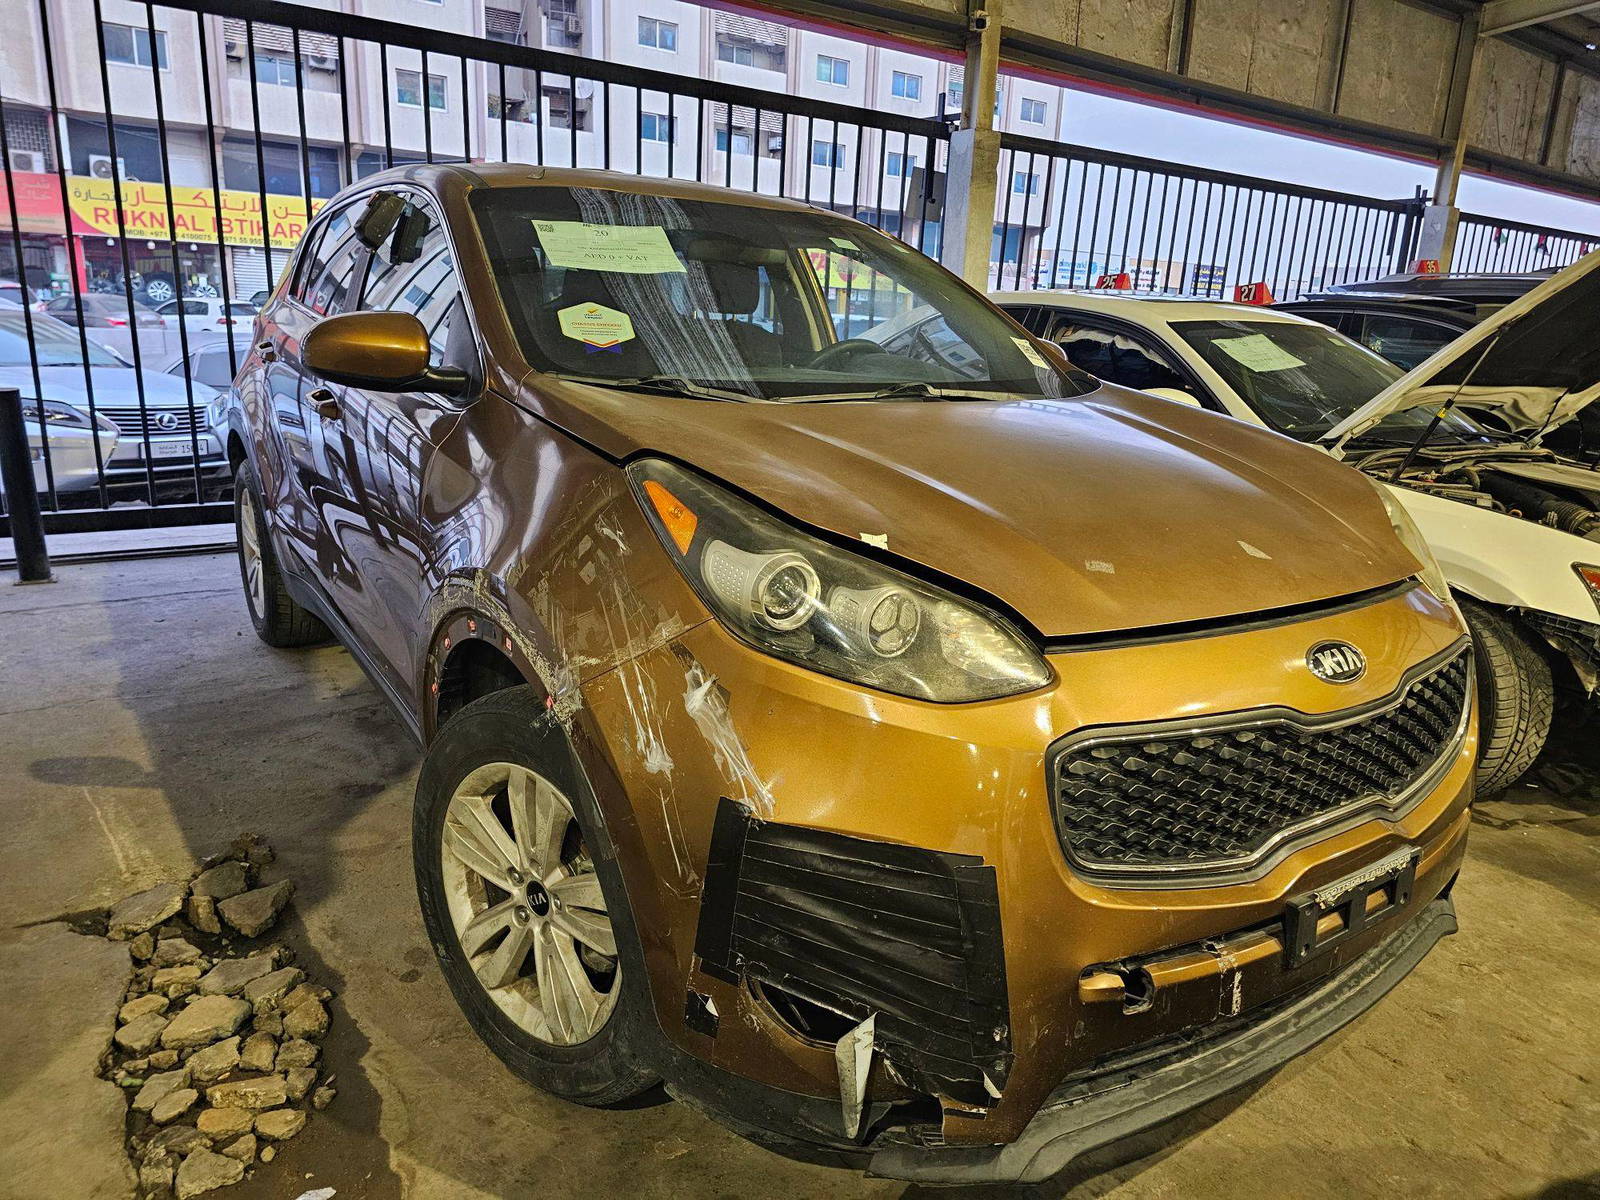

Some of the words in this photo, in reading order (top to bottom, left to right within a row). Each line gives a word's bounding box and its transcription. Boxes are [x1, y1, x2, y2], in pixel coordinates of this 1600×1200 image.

[93, 207, 166, 229] RUKN
[175, 213, 205, 232] AL
[1101, 275, 1118, 289] 25
[1240, 284, 1256, 302] 27
[1314, 645, 1363, 677] KIA
[528, 891, 547, 905] KIA
